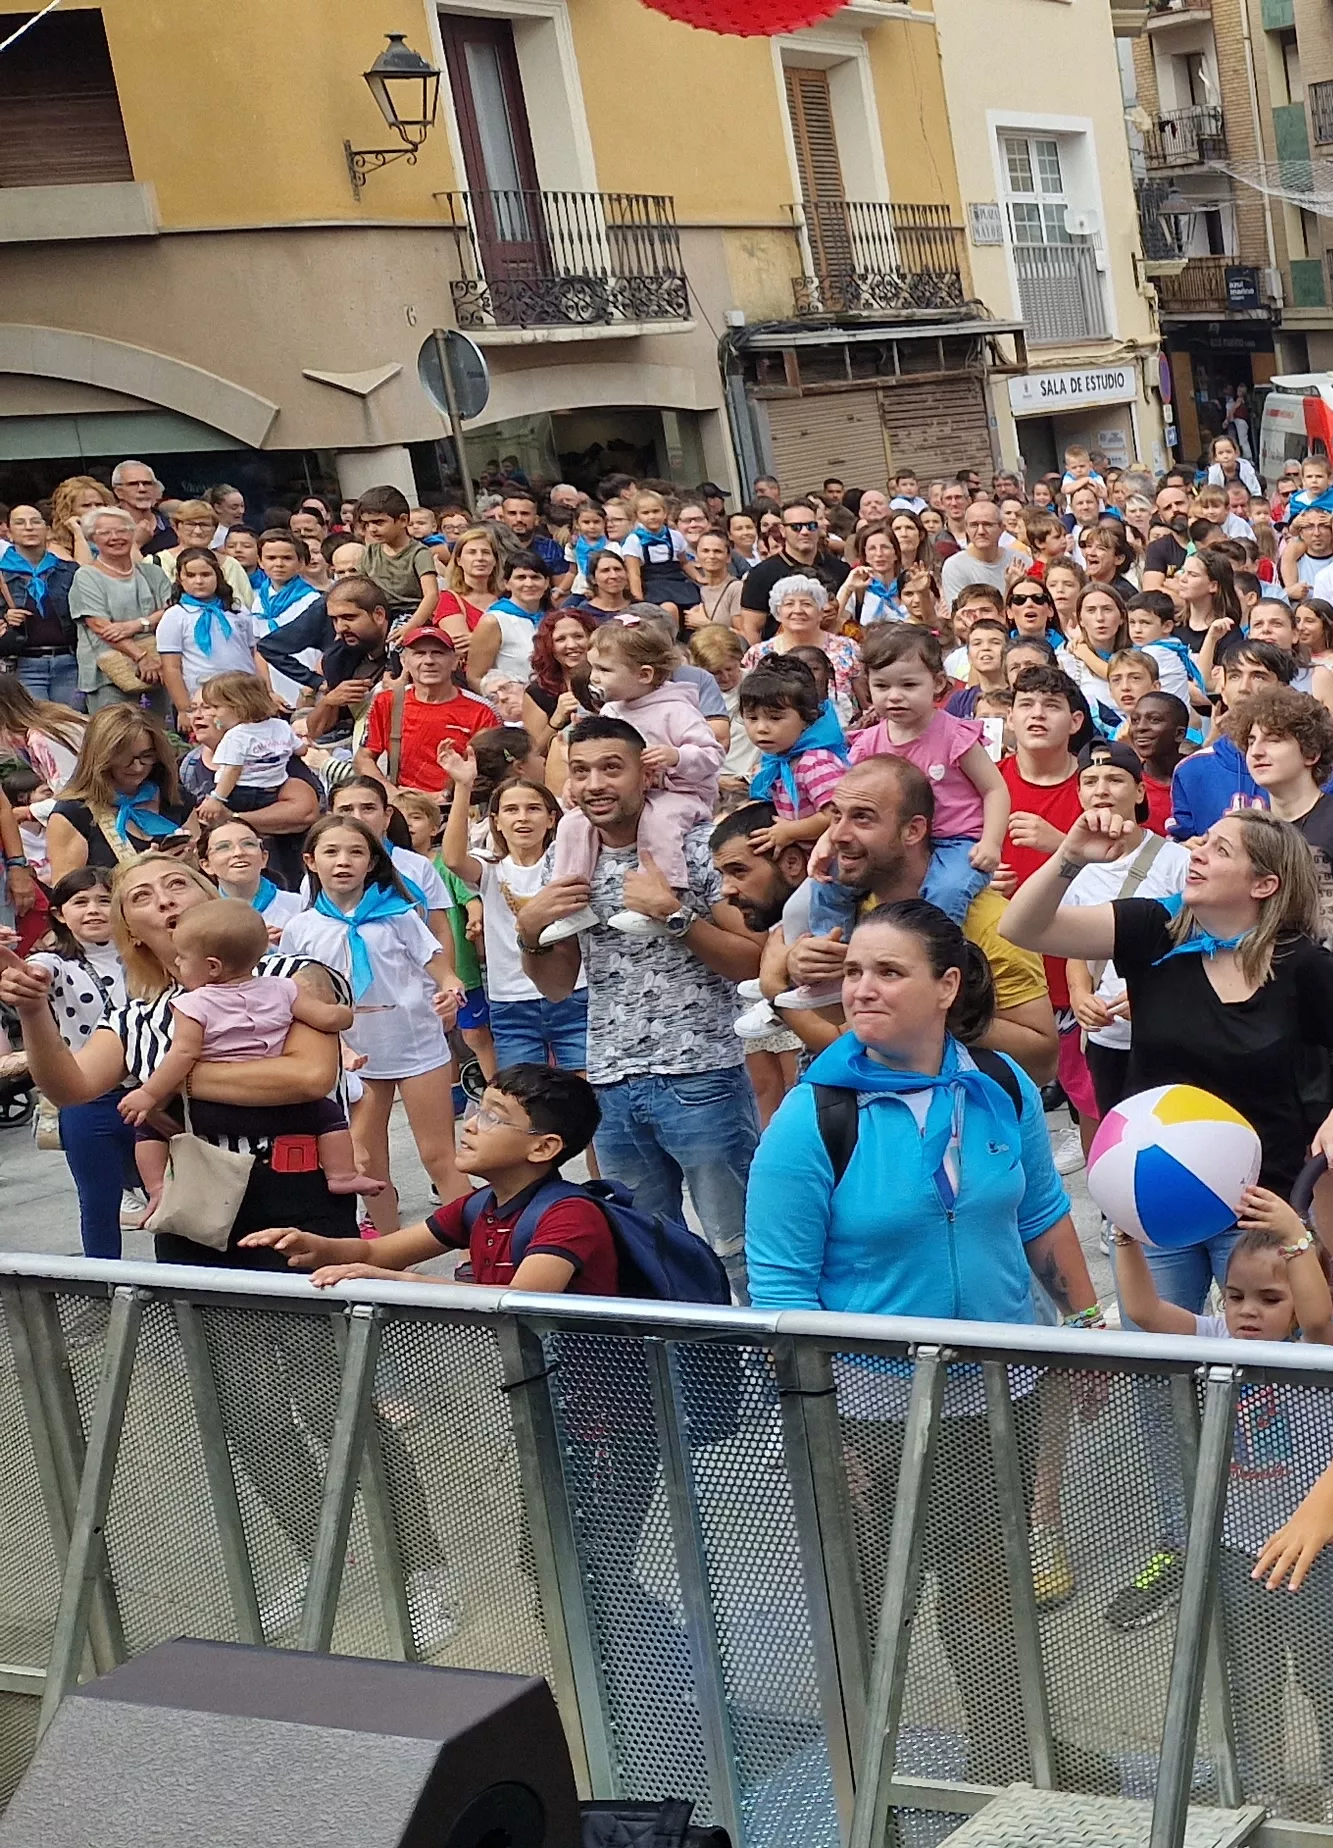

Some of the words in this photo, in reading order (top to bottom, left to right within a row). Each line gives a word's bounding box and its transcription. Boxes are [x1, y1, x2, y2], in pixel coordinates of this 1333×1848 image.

[1040, 378, 1067, 397] SALA
[1070, 377, 1083, 394] DE
[1085, 372, 1125, 392] ESTUDIO
